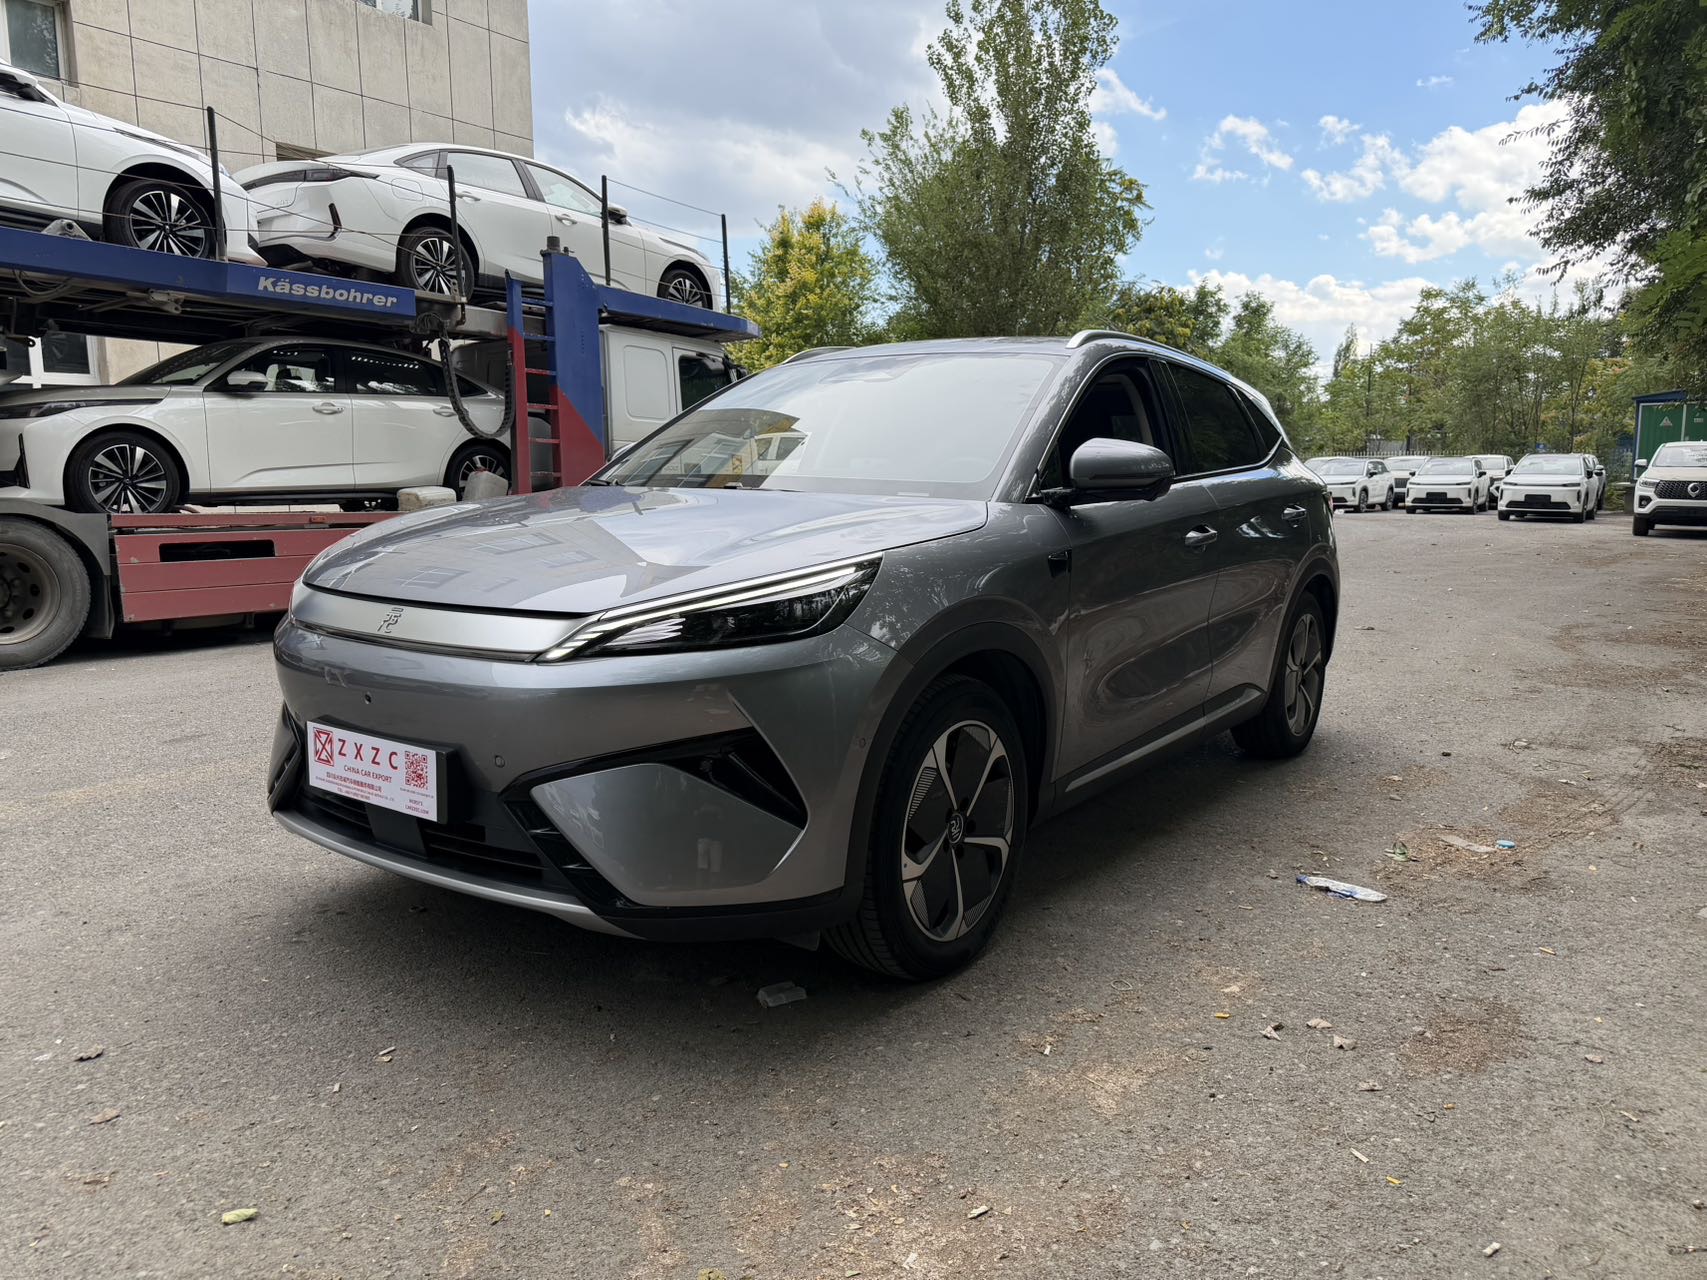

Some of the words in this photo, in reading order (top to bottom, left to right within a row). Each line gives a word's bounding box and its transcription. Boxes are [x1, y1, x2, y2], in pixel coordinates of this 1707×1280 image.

[258, 276, 397, 307] Kässbohrer
[344, 765, 360, 775] CHINA
[361, 768, 371, 779] CAR
[372, 771, 392, 784] EXPORT
